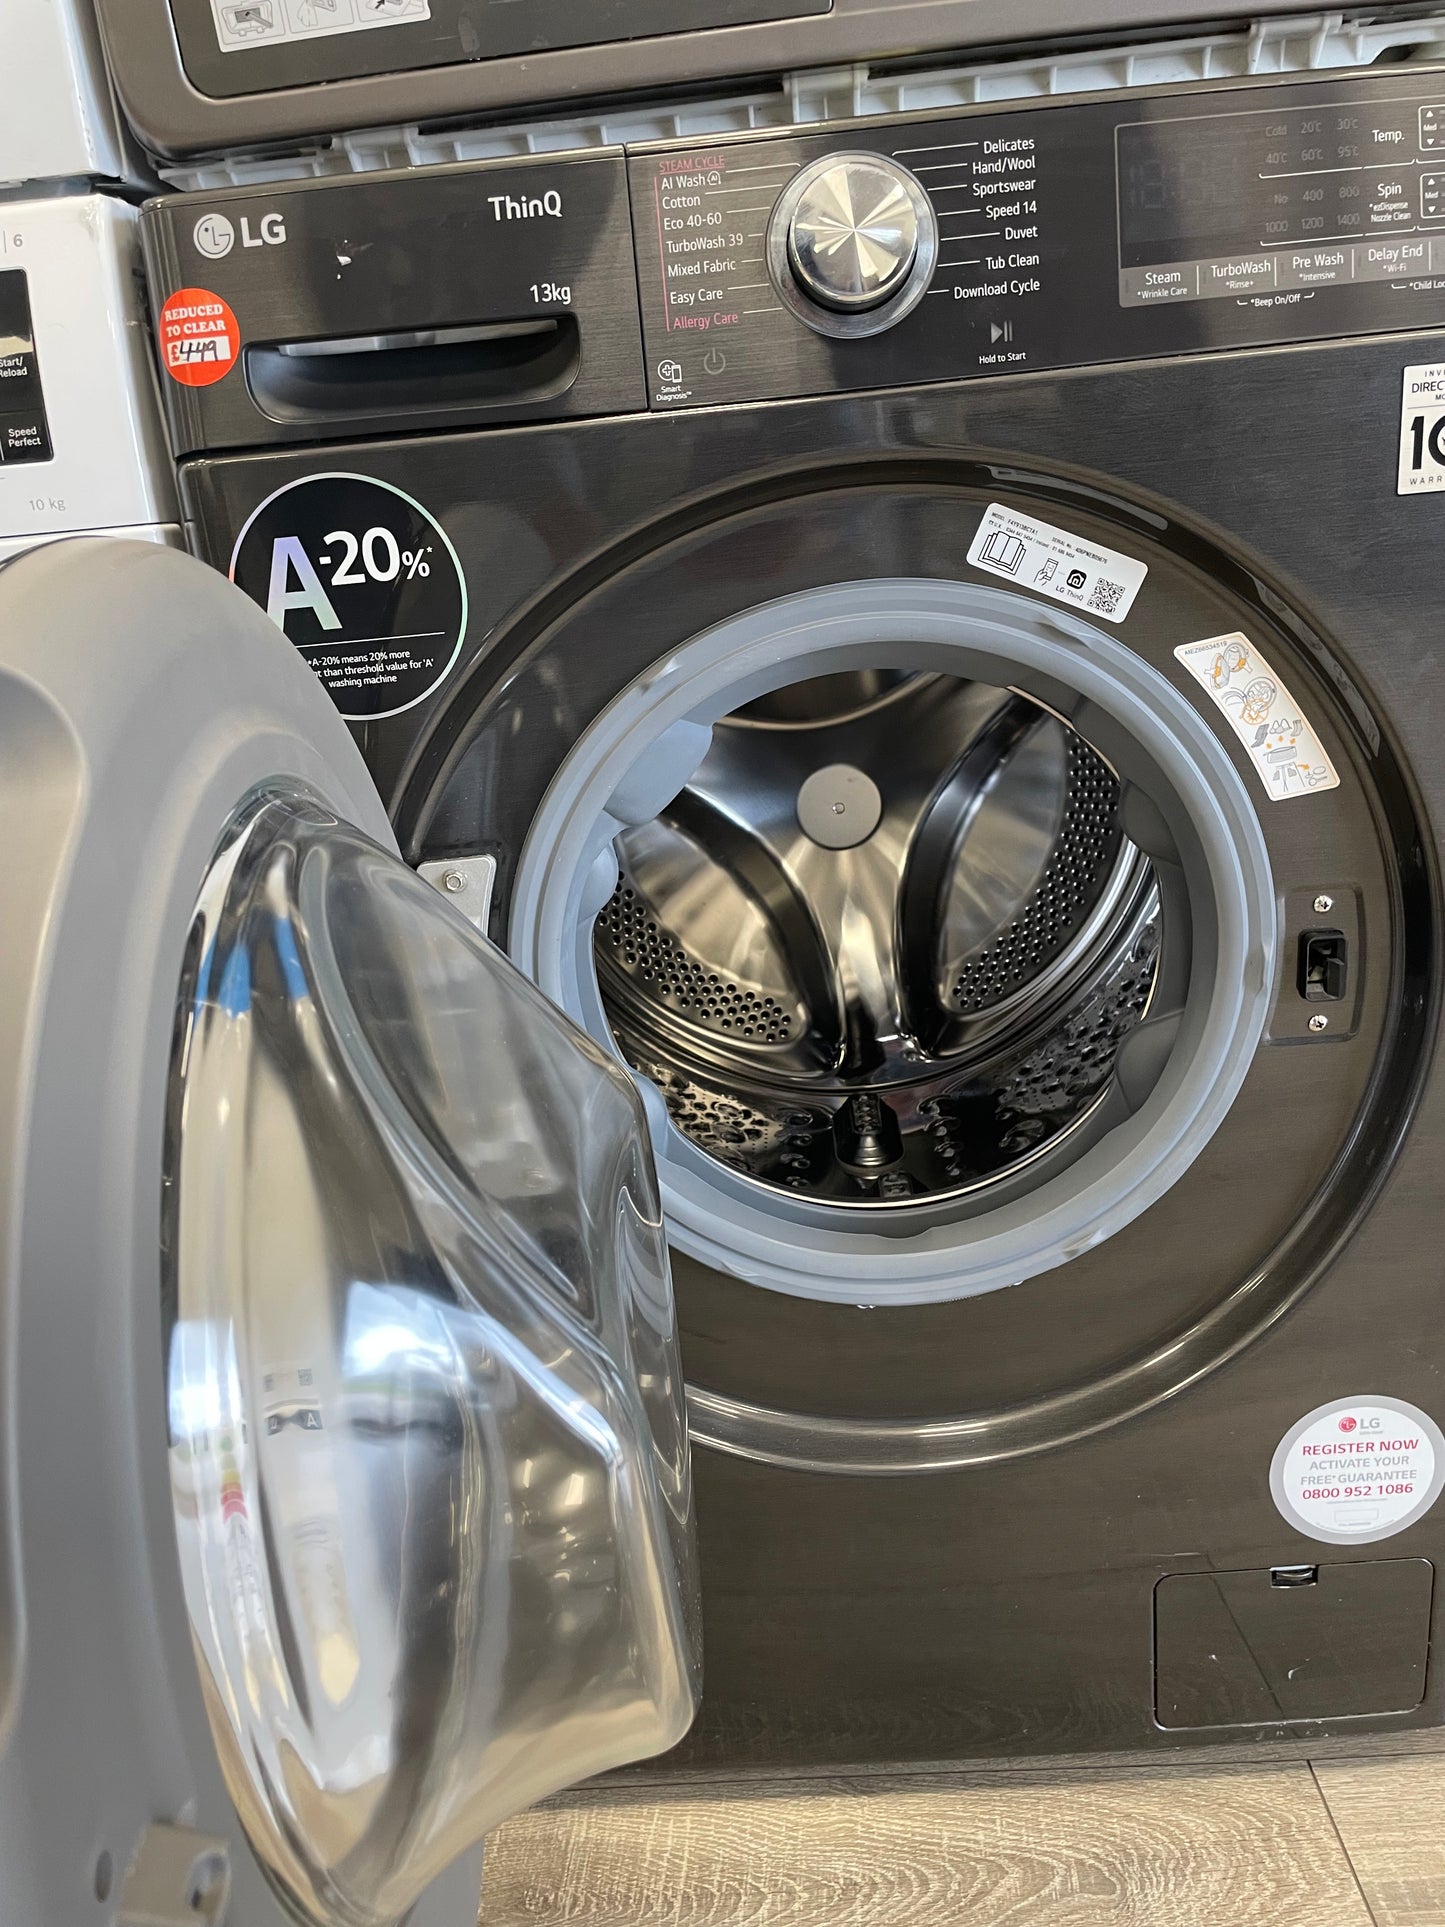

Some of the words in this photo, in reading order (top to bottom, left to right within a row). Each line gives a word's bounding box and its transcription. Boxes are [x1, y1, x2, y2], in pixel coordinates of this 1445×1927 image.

[1265, 125, 1288, 137] Cold
[1371, 129, 1406, 144] Temp.
[983, 138, 1035, 154] Delicates
[660, 159, 693, 173] STEAM
[694, 154, 726, 168] CYCLE
[972, 154, 1036, 175] Hand/Wool
[661, 177, 673, 190] AI
[675, 173, 706, 188] Wash
[972, 179, 1037, 199] Sportswear
[1302, 188, 1324, 201] 400
[1339, 186, 1360, 198] 800
[1377, 182, 1402, 199] Spin
[487, 190, 563, 221] ThinQ
[662, 196, 701, 209] Cotton
[985, 201, 1020, 220] Speed
[1022, 200, 1037, 214] 14
[663, 217, 684, 230] Eco
[686, 211, 722, 227] 40-60
[1301, 217, 1324, 230] 1200
[1337, 213, 1361, 226] 1400
[1370, 213, 1392, 223] Nozzle
[1392, 211, 1412, 221] Clean
[240, 213, 287, 248] LG
[1004, 225, 1038, 240] Duvet
[1265, 221, 1289, 233] 1000
[13, 233, 23, 248] 6
[665, 235, 726, 253] TurboWash
[728, 233, 744, 247] 39
[1292, 256, 1311, 269] Pre
[1314, 252, 1344, 267] Wash
[1368, 247, 1399, 262] Delay
[1402, 244, 1423, 258] End
[667, 261, 701, 277] Mixed
[703, 257, 737, 273] Fabric
[985, 255, 1006, 270] Tub
[1008, 253, 1040, 268] Clean
[1211, 260, 1271, 278] TurboWash
[1145, 271, 1181, 286] Steam
[529, 283, 572, 305] 13kg
[669, 292, 695, 305] Easy
[697, 288, 724, 302] Care
[953, 280, 1008, 300] Download
[1010, 277, 1041, 296] Cycle
[1170, 287, 1188, 297] Care
[1274, 293, 1301, 305] On/Off
[164, 304, 224, 322] REDUCED
[673, 315, 711, 330] Allergy
[713, 312, 739, 325] Care
[167, 325, 181, 338] TO
[183, 320, 226, 334] CLEAR
[979, 354, 997, 364] Hold
[1007, 351, 1027, 361] Start
[660, 385, 682, 393] Smart
[8, 426, 38, 439] Speed
[8, 437, 42, 448] Perfect
[29, 498, 45, 511] 10
[50, 497, 66, 512] kg
[1055, 585, 1065, 593] LG
[1067, 590, 1084, 601] ThinQ
[341, 654, 369, 664] means
[369, 651, 388, 662] 20%
[389, 650, 411, 659] more
[323, 667, 343, 677] than
[344, 663, 385, 675] threshold
[385, 661, 408, 672] value
[409, 659, 422, 669] for
[328, 678, 362, 688] washing
[363, 674, 398, 685] machine
[1360, 1418, 1380, 1430] LG
[1302, 1442, 1375, 1456] REGISTER
[1379, 1439, 1420, 1451] NOW
[1309, 1458, 1371, 1471] ACTIVATE
[1374, 1456, 1409, 1467] YOUR
[1338, 1470, 1417, 1484] GUARANTEE
[1302, 1488, 1340, 1500] 0800
[1344, 1486, 1372, 1498] 952
[1378, 1483, 1413, 1495] 1086
